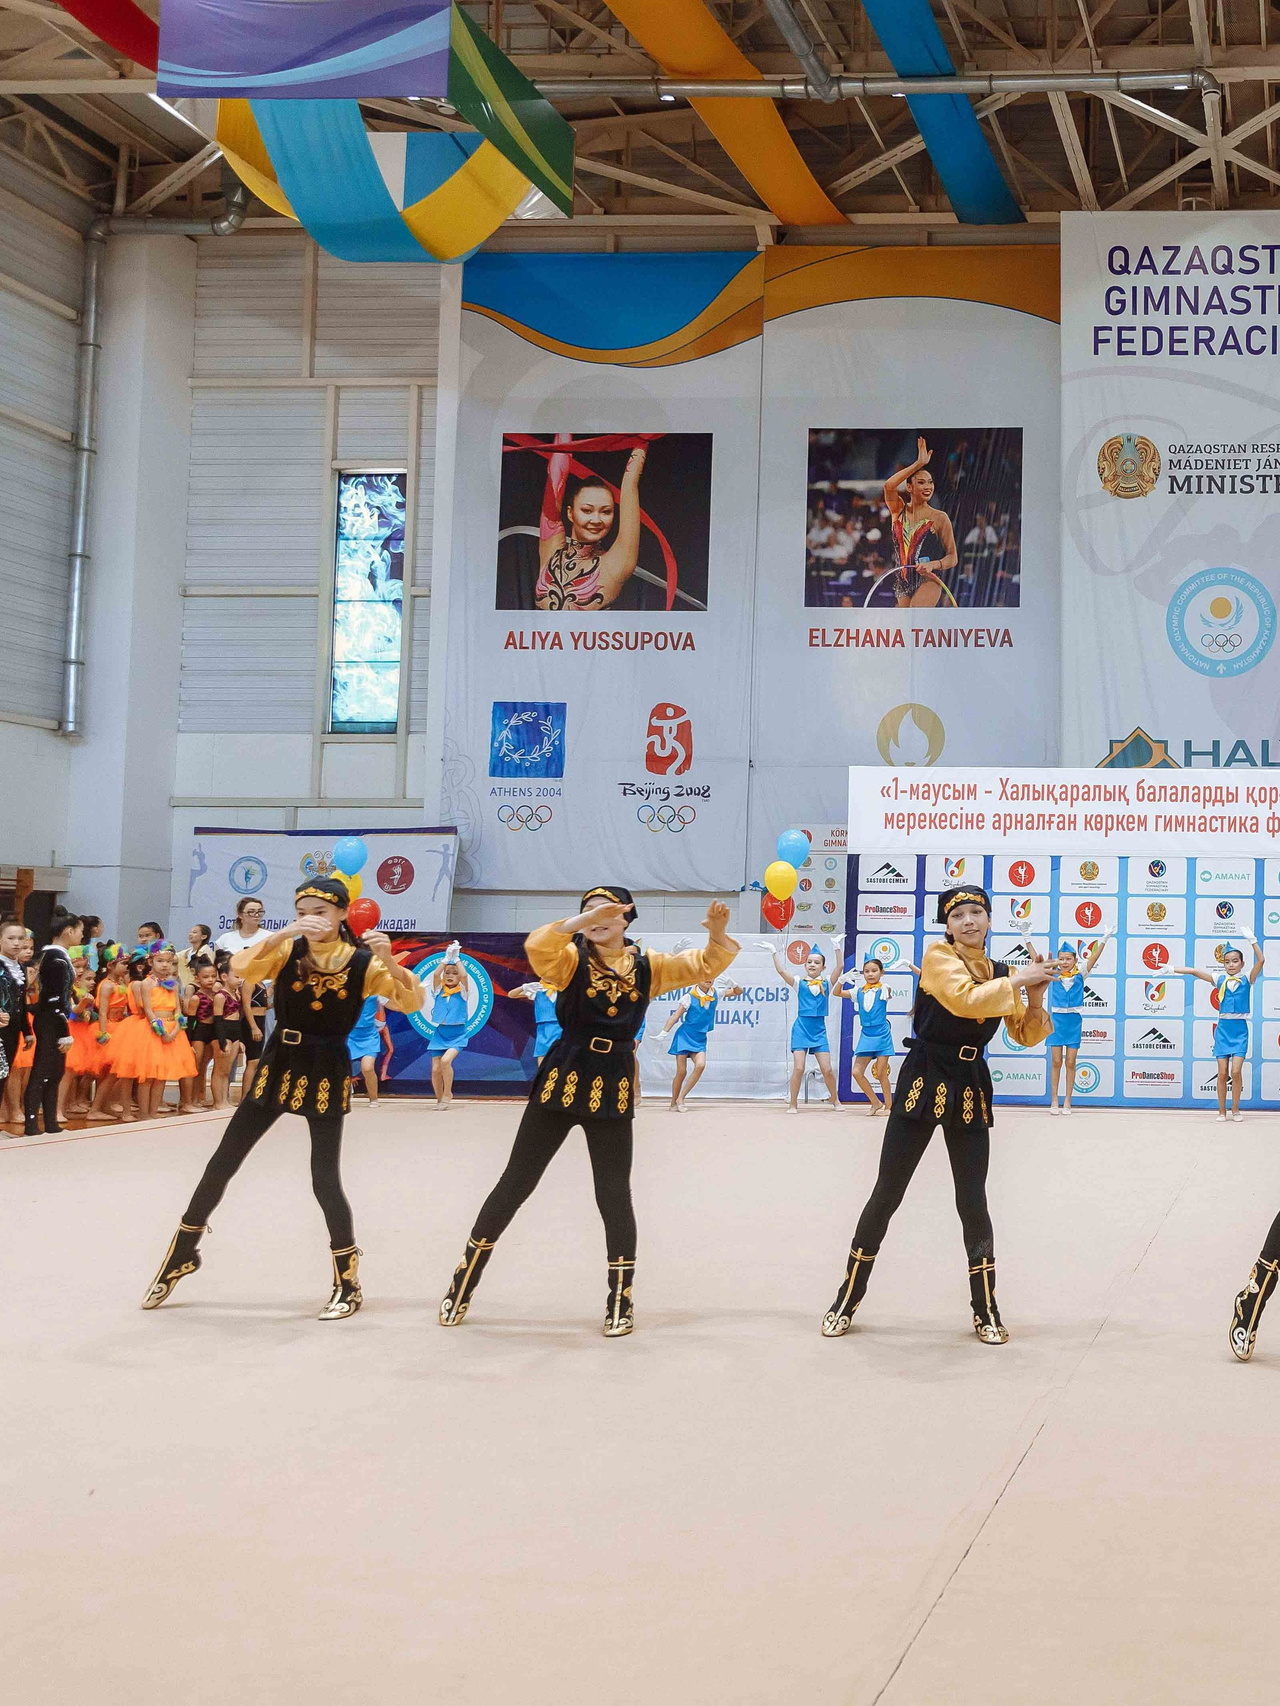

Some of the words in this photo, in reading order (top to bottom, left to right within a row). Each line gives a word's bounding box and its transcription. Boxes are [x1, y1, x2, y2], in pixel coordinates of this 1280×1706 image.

[1168, 443, 1247, 454] QAZAQSTAN
[1168, 454, 1251, 470] MÁDENIET
[1230, 574, 1246, 584] THE
[1177, 574, 1216, 605] COMMITTEE
[1246, 581, 1271, 615] REPUBLIC
[1172, 606, 1181, 641] OLYMPIC
[1264, 617, 1272, 628] OF
[504, 630, 563, 650] ALIYA
[570, 631, 695, 651] YUSSUPOVA
[808, 627, 904, 649] ELZHANA
[911, 627, 1013, 649] TANIYEVA
[1179, 643, 1210, 670] NATIONAL
[1233, 629, 1271, 670] KAZAKHSTAN
[490, 787, 532, 797] ATHENS
[535, 787, 562, 797] 2004
[618, 782, 670, 802] Beijing
[674, 785, 711, 798] 2008
[880, 777, 978, 807] «1-маусым
[999, 777, 1129, 806] Халықаралық
[1136, 779, 1239, 810] балаларды
[884, 807, 985, 836] мерекесіне
[992, 811, 1077, 837] арналған
[1084, 811, 1147, 838] көркем
[1154, 813, 1259, 834] гимнастика
[823, 839, 847, 847] GIMNA
[831, 828, 848, 838] KÖRK
[1214, 873, 1251, 881] AMANAT
[865, 905, 908, 914] ProDanceShop
[469, 963, 489, 992] REPUBLIC
[412, 1013, 434, 1035] ATIONAL
[467, 1004, 488, 1032] KAZAKHS
[1081, 1029, 1107, 1038] nceShop
[1005, 1073, 1042, 1081] AMANAT
[1131, 1071, 1175, 1080] ProDanceShop
